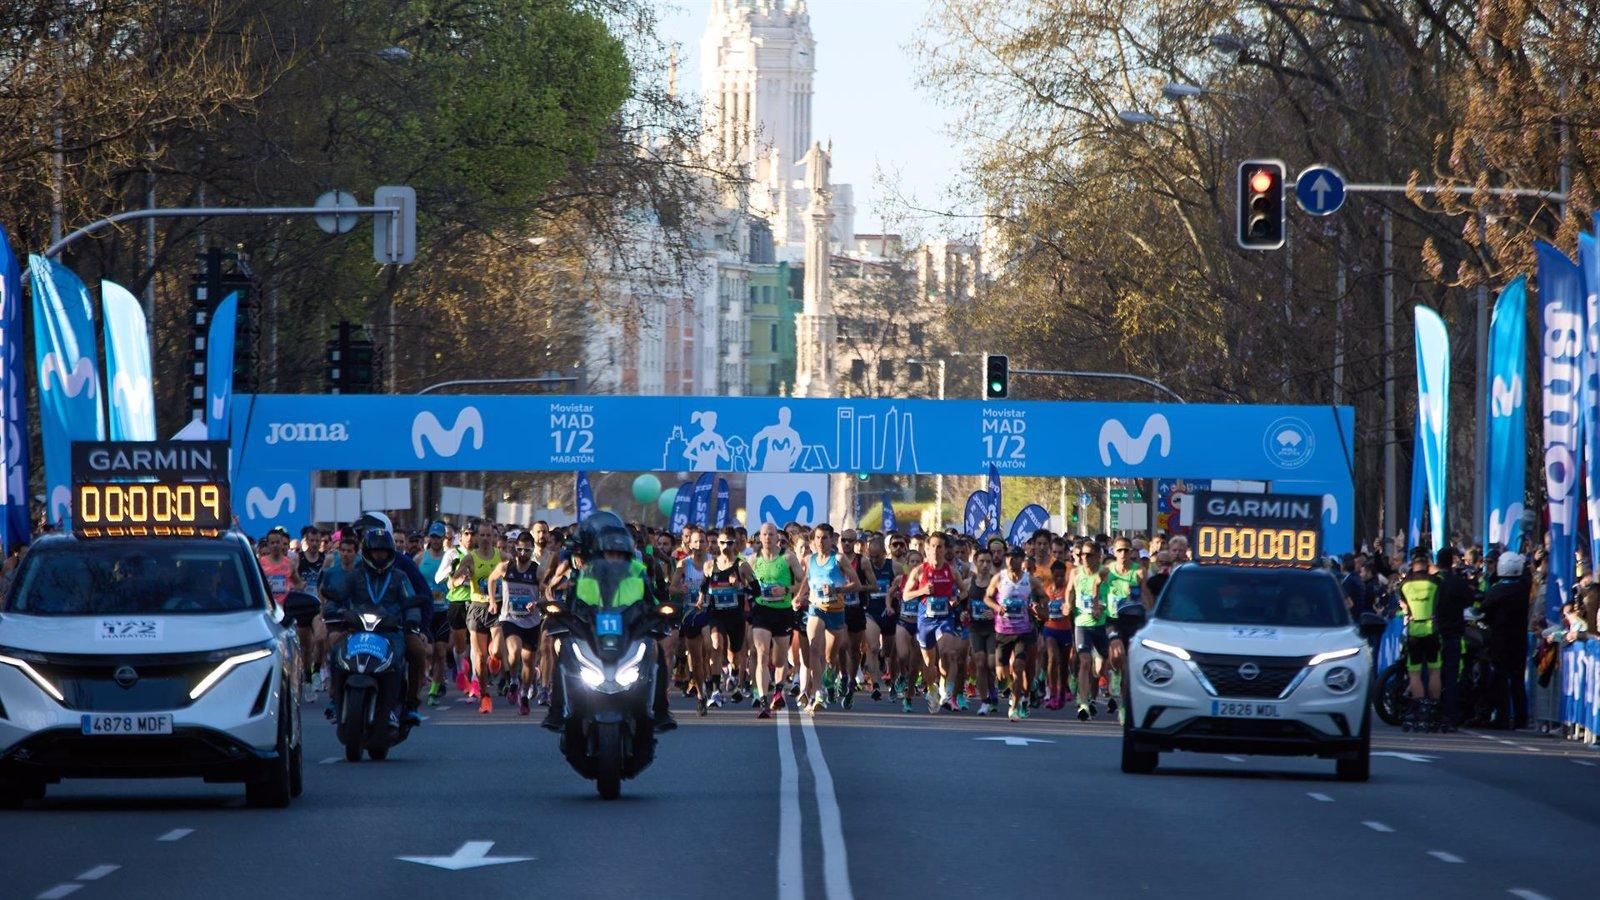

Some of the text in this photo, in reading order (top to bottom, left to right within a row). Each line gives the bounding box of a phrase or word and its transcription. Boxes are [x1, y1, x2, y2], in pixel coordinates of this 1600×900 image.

[550, 403, 594, 412] Movistar
[982, 408, 1026, 417] Movistar
[550, 414, 594, 429] MAD
[982, 419, 1026, 434] MAD
[550, 430, 594, 454] 1/2
[982, 435, 1026, 459] 1/2
[89, 449, 213, 471] GARMIN
[550, 455, 595, 464] MARATÓN
[81, 485, 220, 523] 00:00:09
[1207, 499, 1311, 519] GARMIN
[602, 619, 617, 631] 11
[1220, 703, 1281, 718] 2826 MDL
[93, 716, 167, 732] 4878 MDF
